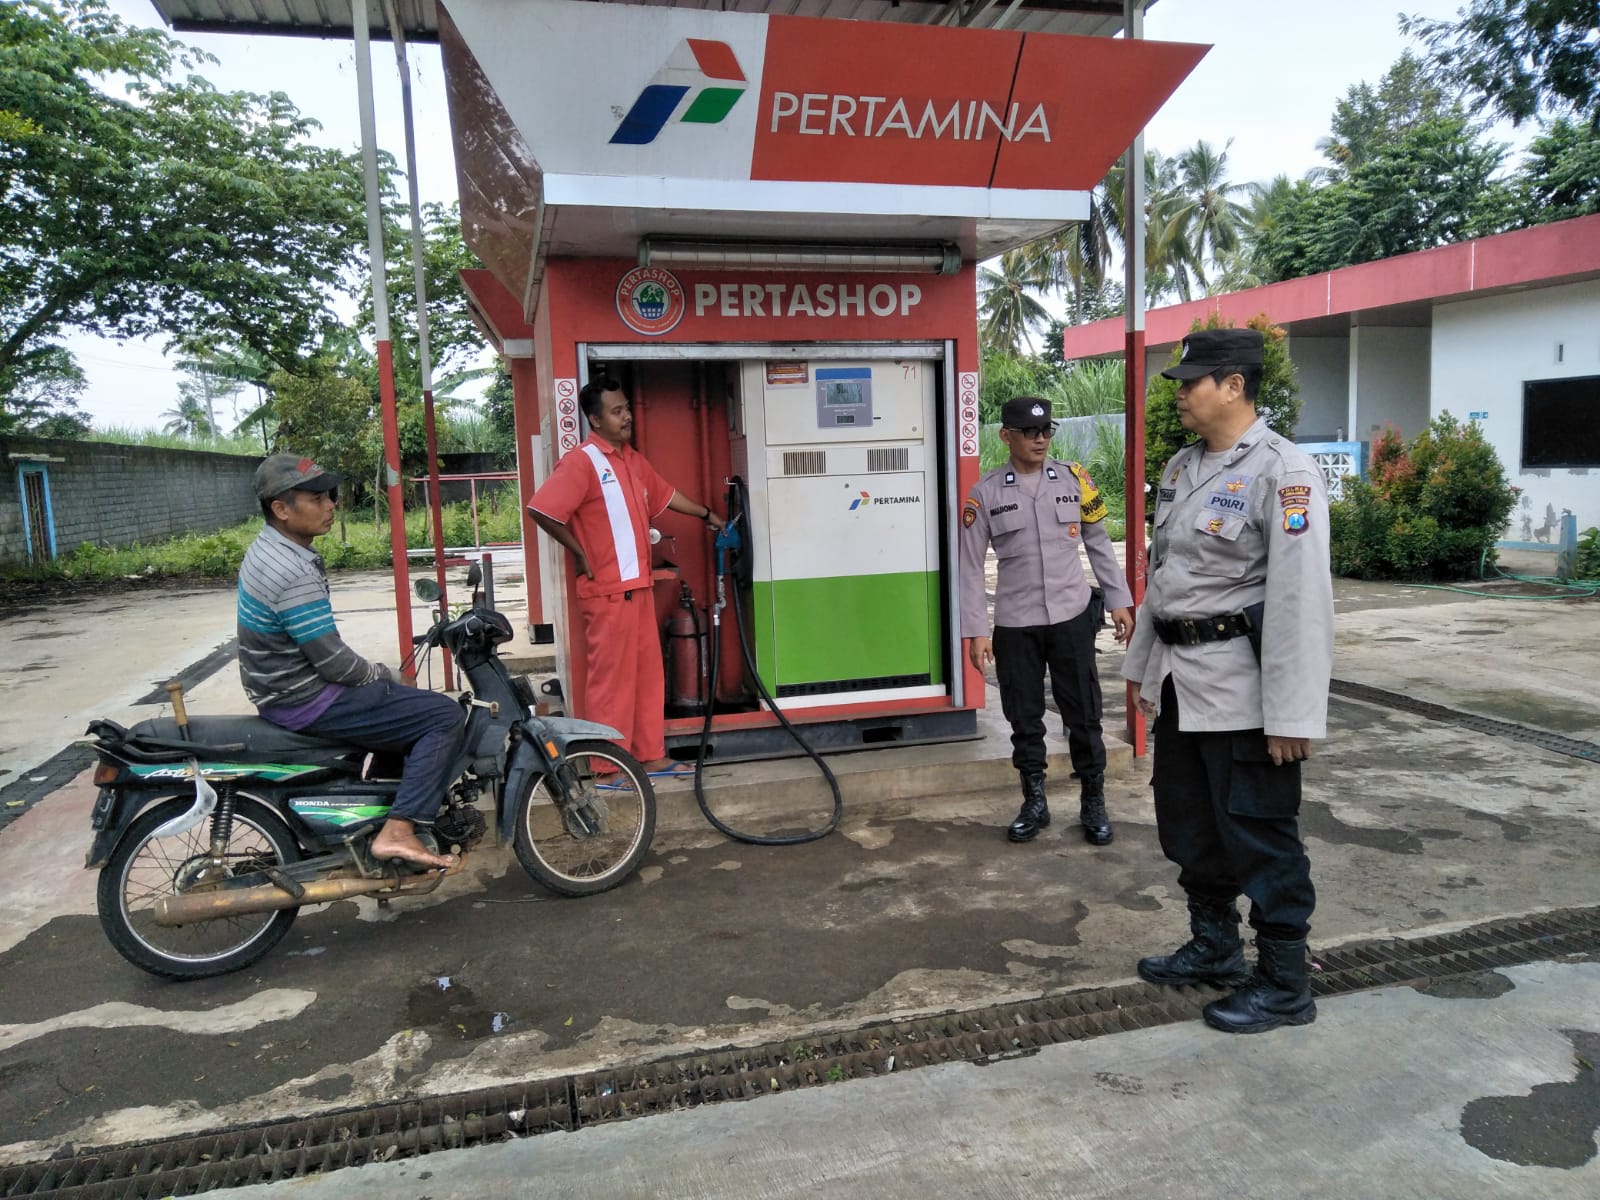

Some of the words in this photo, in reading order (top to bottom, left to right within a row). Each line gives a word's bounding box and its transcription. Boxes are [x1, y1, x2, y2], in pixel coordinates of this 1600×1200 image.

[770, 91, 1051, 143] PERTAMINA
[620, 269, 680, 296] PERTASHOP
[694, 284, 922, 317] PERTASHOP
[902, 365, 916, 381] 71
[873, 496, 920, 505] PERTAMINA
[1211, 496, 1245, 511] POLRI
